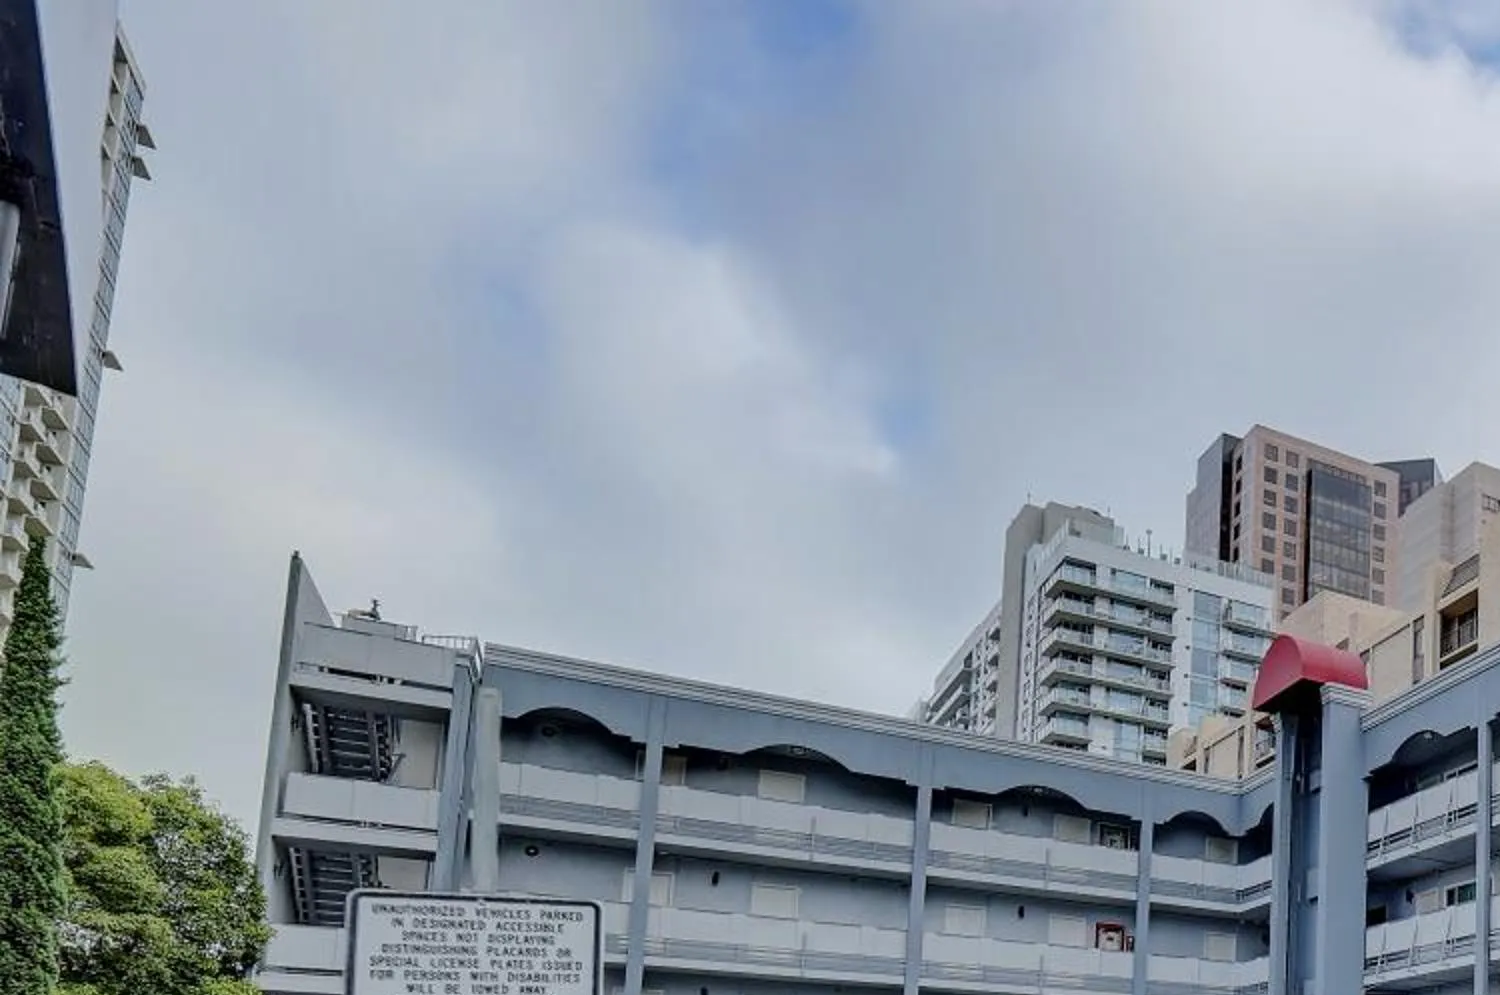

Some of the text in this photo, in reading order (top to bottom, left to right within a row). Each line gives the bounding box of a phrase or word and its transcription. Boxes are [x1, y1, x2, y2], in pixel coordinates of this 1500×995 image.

[372, 904, 583, 921] UNAUTHORIZED VEHICLES PARKED
[391, 917, 564, 934] IN DESIGNATED ACCESSIBLE
[401, 930, 555, 945] SPACES NOT DISPLAYING
[382, 943, 478, 956] DISTINGUISHING
[486, 946, 547, 957] PLACARDS
[369, 956, 583, 971] SPECIAL LICENSE PLATES ISSUED
[369, 969, 581, 983] FOR PERSONS WITH DISABILITIES
[406, 983, 547, 995] WILL BE TOWED AWAY
